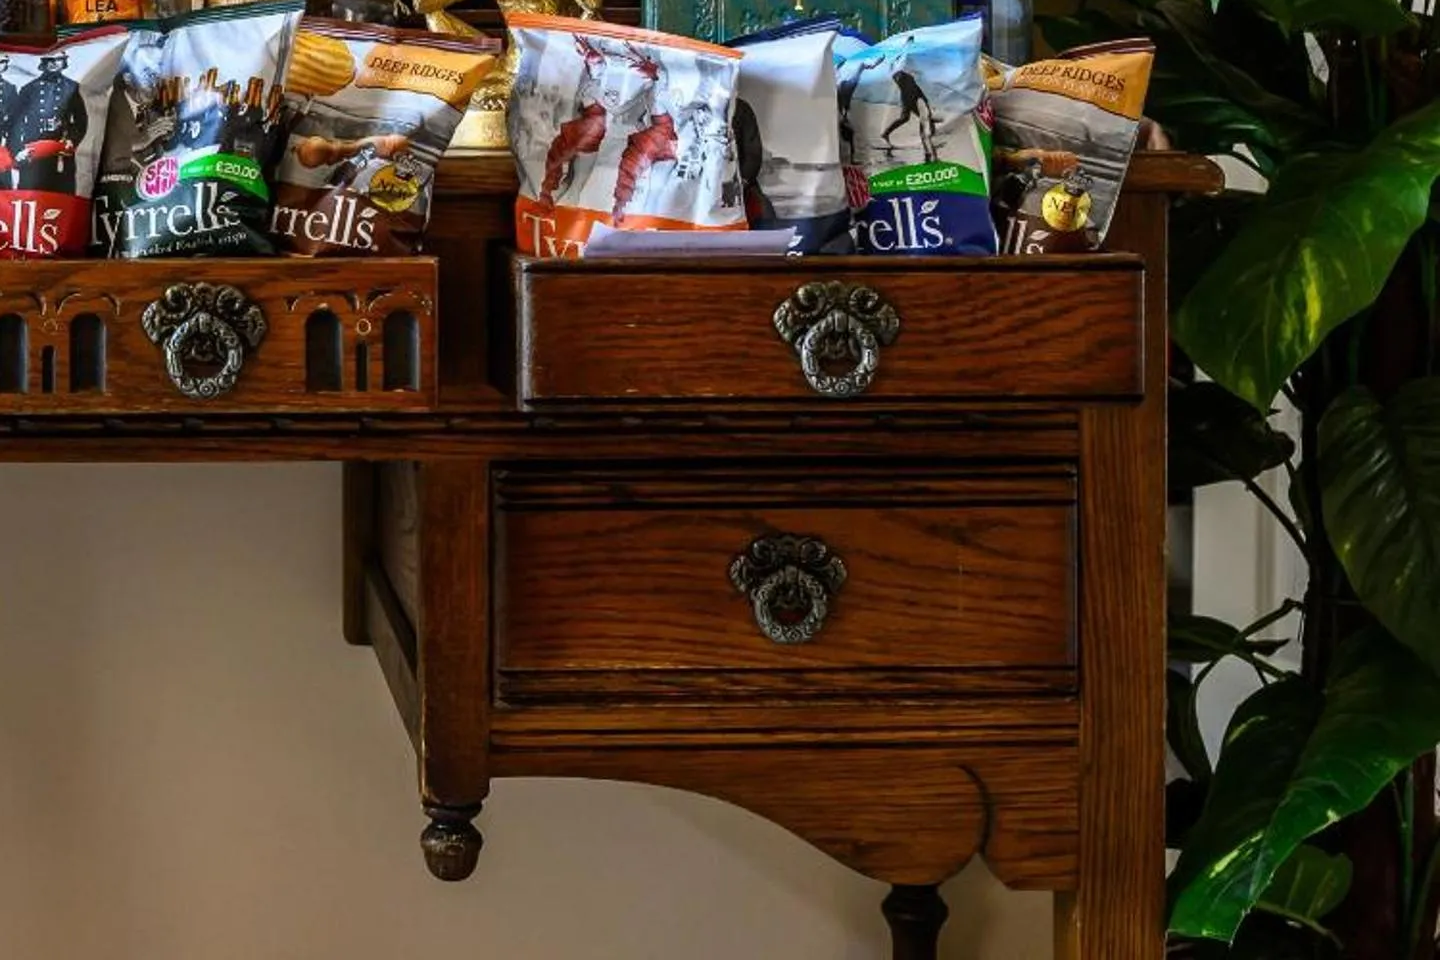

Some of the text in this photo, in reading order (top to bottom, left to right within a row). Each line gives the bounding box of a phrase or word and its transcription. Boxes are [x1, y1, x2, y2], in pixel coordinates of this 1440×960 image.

[86, 0, 118, 12] LEA
[368, 57, 409, 74] DEEP
[1061, 66, 1127, 90] RIDGES
[906, 166, 958, 186] £20,000
